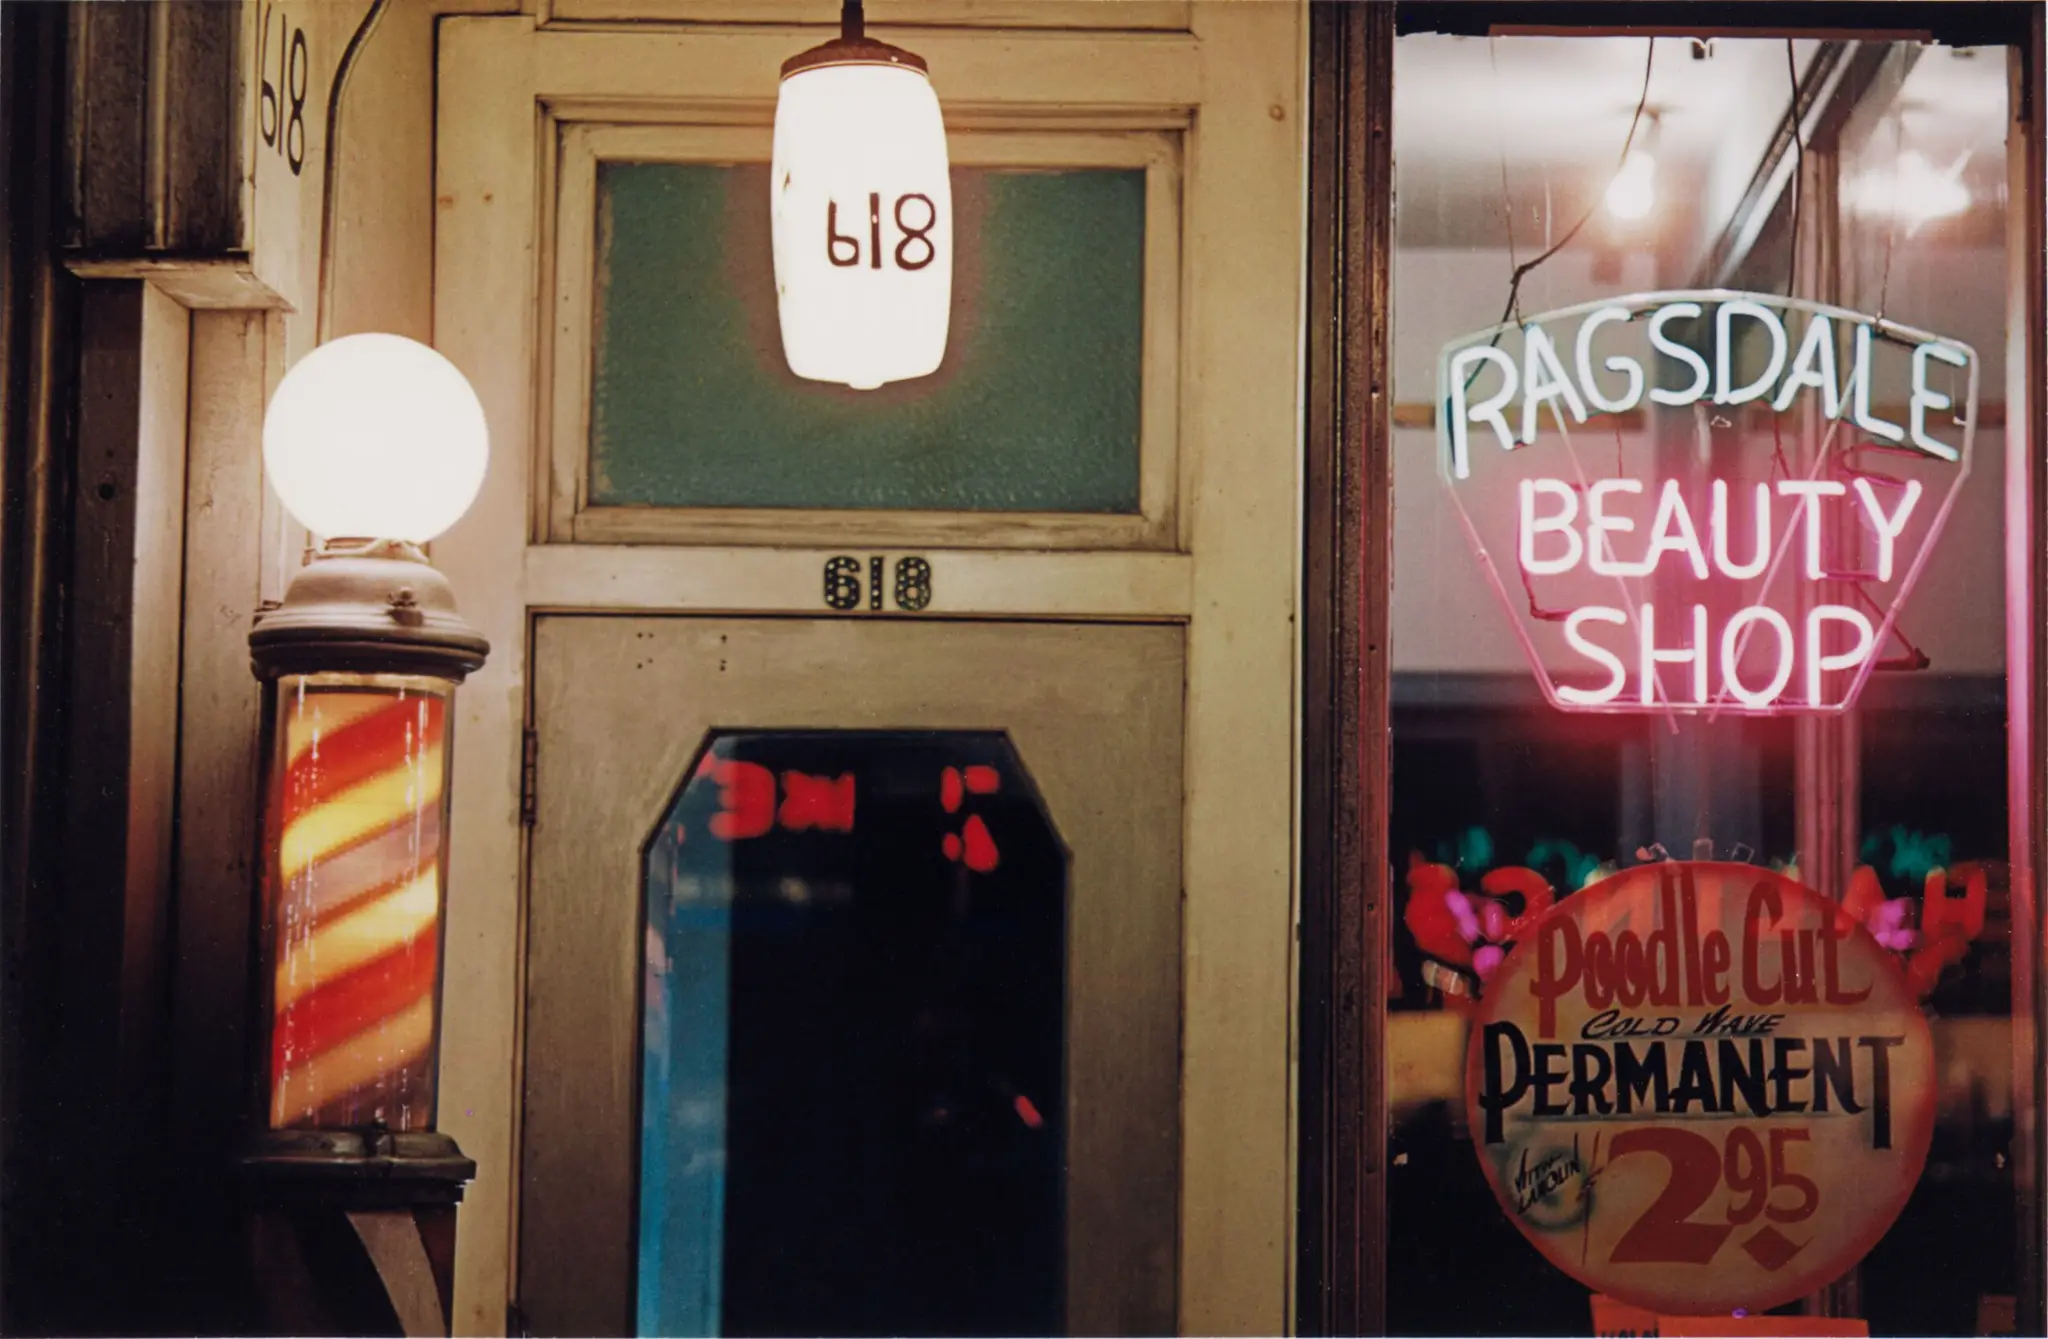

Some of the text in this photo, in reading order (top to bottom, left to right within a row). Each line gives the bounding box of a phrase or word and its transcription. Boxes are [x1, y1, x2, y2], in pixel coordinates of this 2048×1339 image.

[260, 2, 308, 177] 618
[827, 192, 936, 271] 618
[1449, 300, 1967, 479] RAGSDALE
[824, 556, 931, 611] 618
[1518, 478, 1922, 583] BEAUTY
[1555, 602, 1874, 708] SHOP
[1529, 863, 1729, 1039] Poodle
[1741, 881, 1874, 1004] Cut
[1581, 1004, 1785, 1040] COLD WAVE
[1478, 1020, 1905, 1150] PERMANENT
